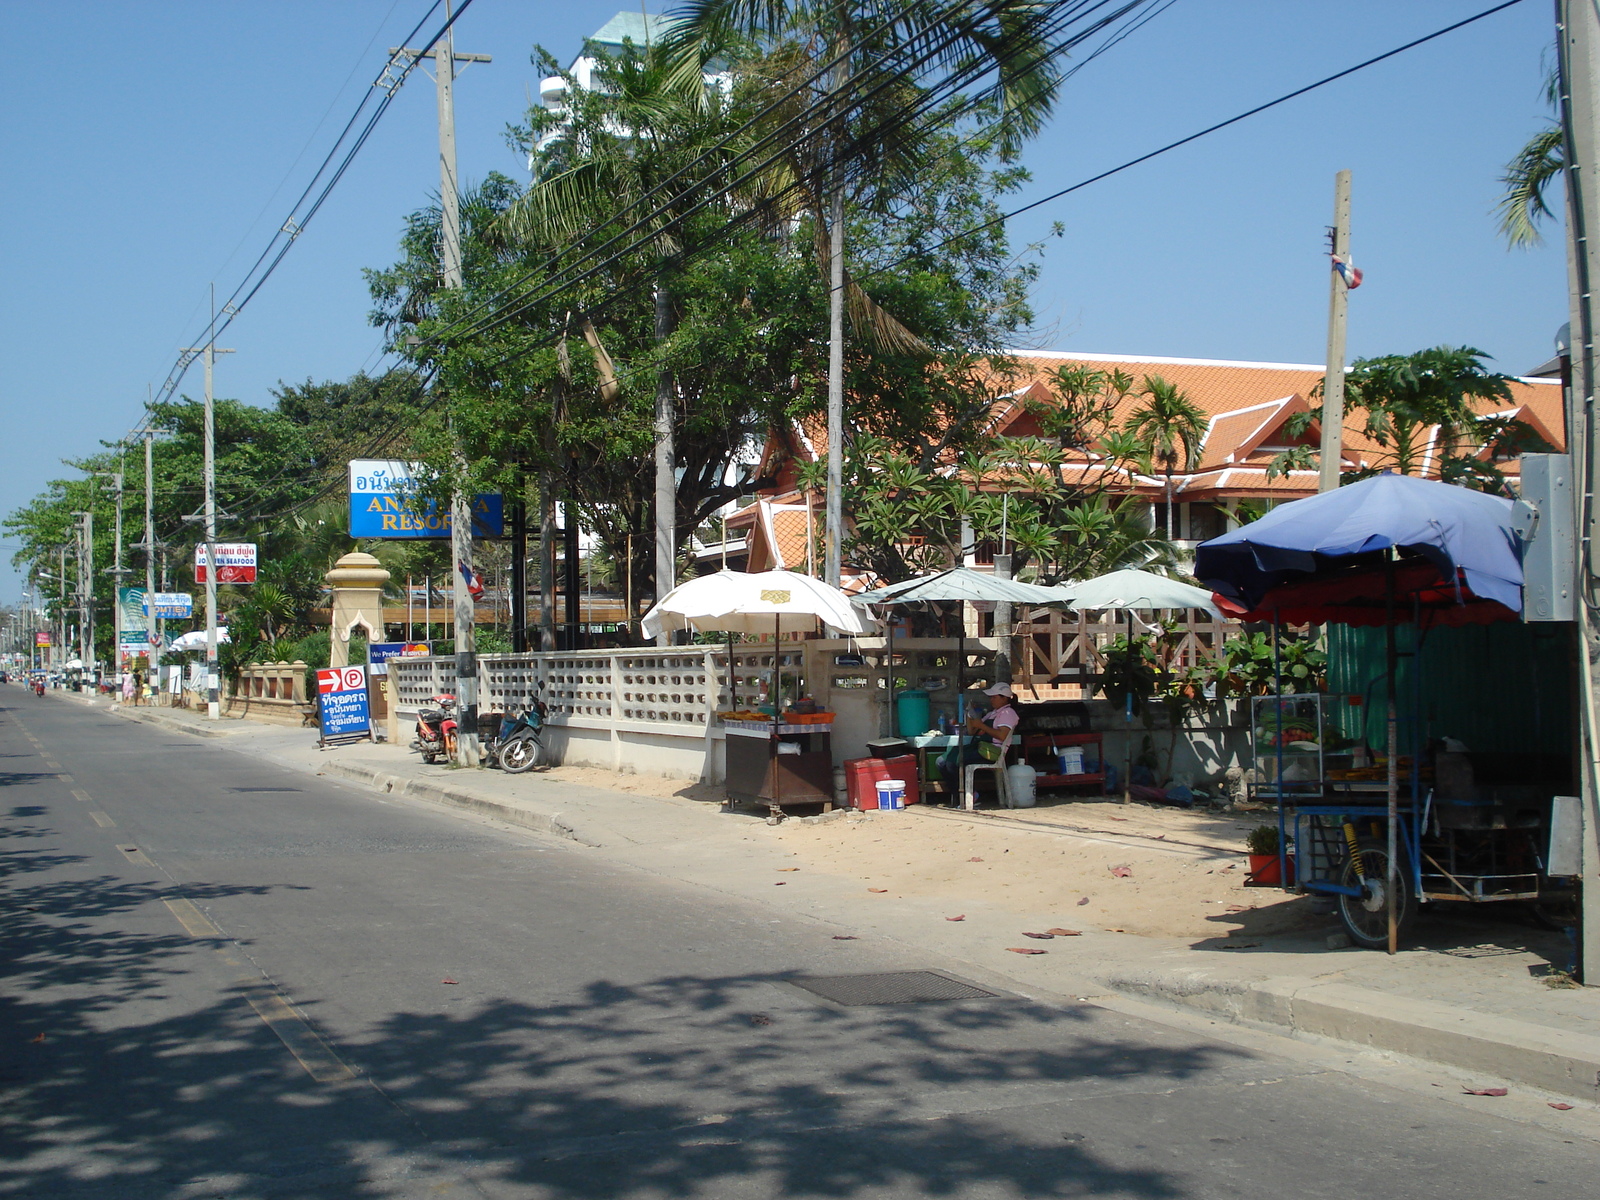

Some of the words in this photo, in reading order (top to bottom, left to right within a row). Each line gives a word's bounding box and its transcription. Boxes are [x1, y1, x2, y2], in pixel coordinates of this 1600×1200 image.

[381, 514, 457, 530] RESOR
[322, 692, 366, 706] ที่จอดรถ
